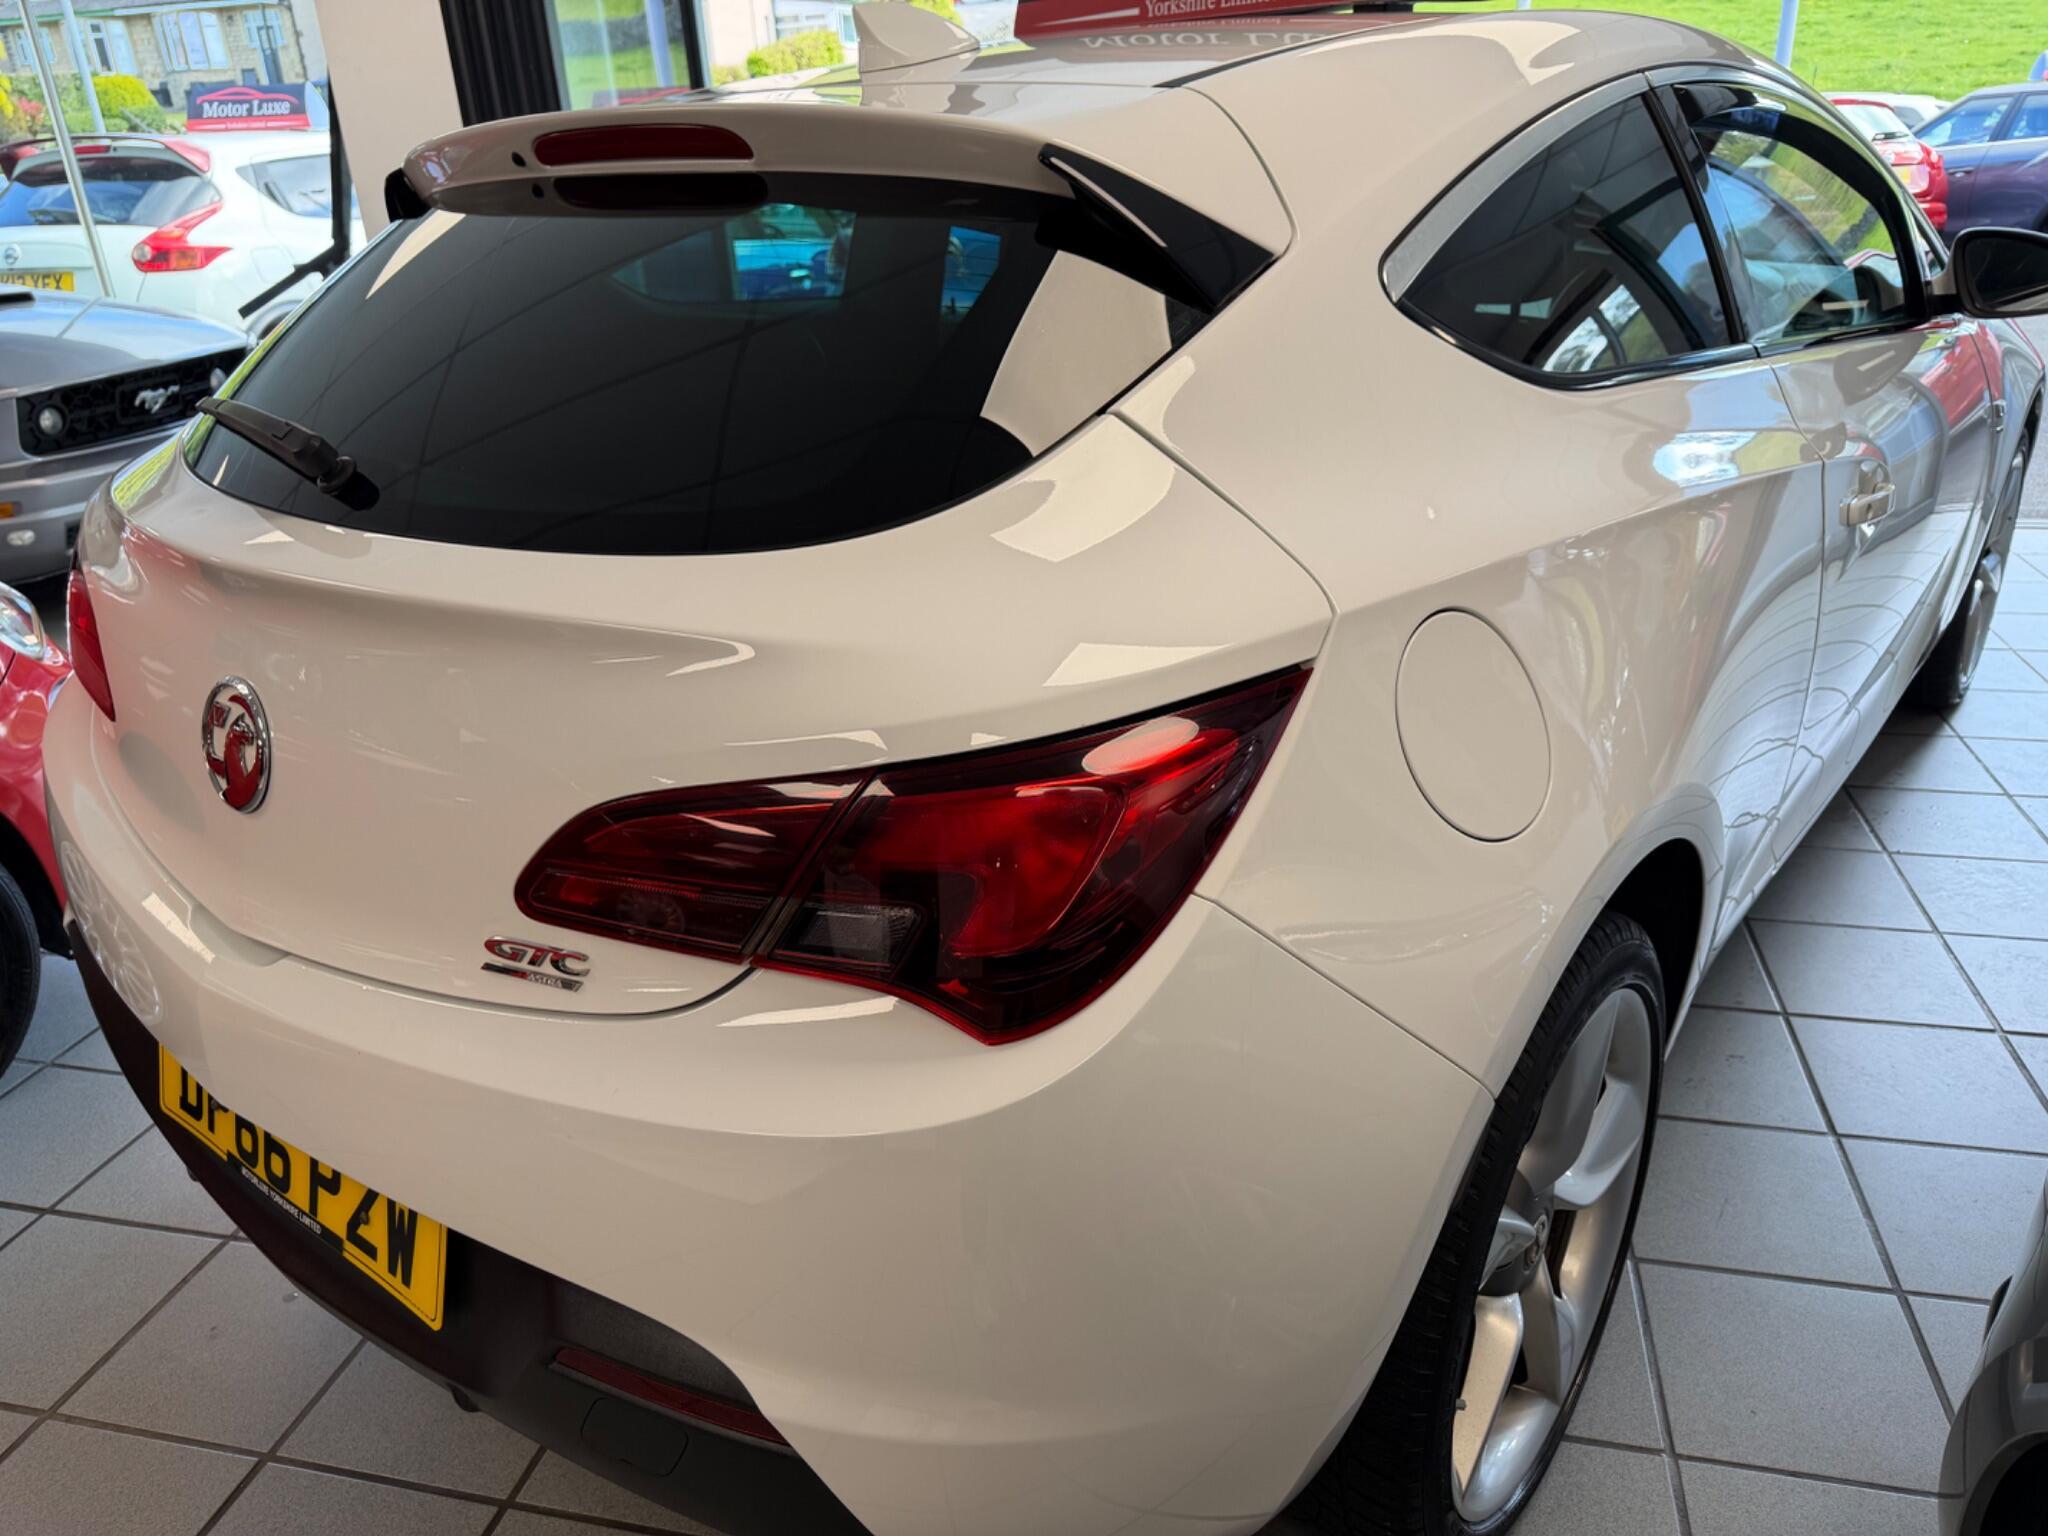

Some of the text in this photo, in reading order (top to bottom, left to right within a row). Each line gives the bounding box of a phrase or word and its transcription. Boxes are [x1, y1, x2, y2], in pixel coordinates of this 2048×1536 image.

[202, 99, 290, 118] Motor Luxe
[483, 936, 591, 977] GTC
[309, 1157, 419, 1290] PZW
